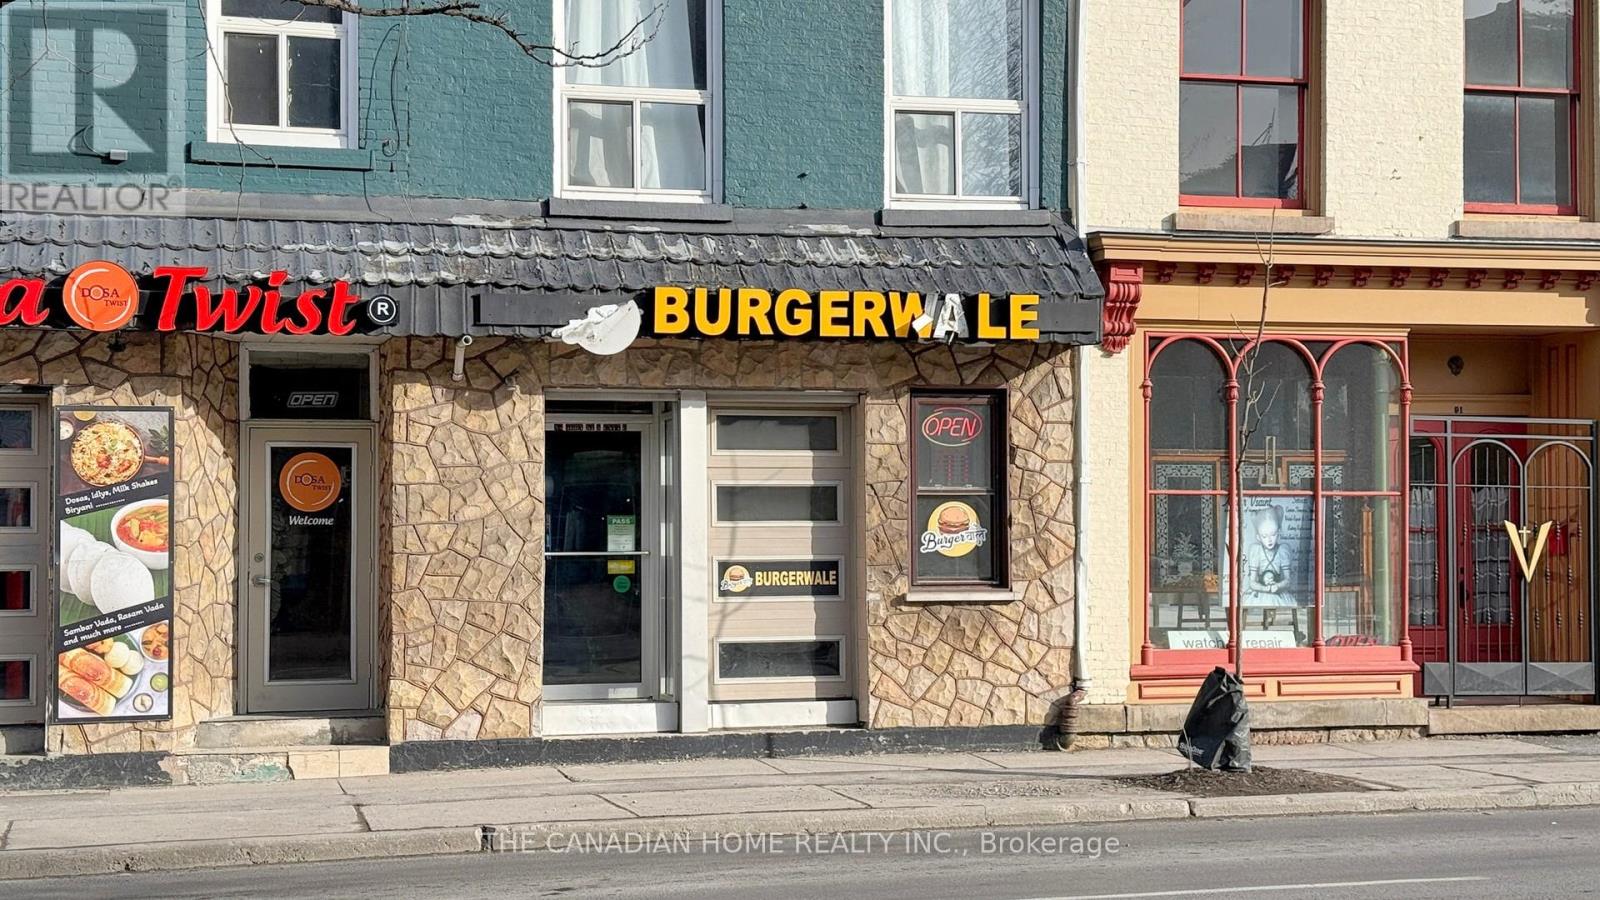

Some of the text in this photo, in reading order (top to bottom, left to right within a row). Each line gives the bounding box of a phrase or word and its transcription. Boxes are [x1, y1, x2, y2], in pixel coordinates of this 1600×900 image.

[81, 287, 118, 301] DOSA
[154, 266, 360, 335] Twist
[653, 286, 1041, 341] BURGERWALE
[289, 394, 336, 406] OPEN
[925, 416, 977, 437] OPEN
[294, 473, 325, 486] DOSA
[65, 495, 91, 505] Dosas,
[112, 484, 130, 494] Milk
[131, 479, 158, 490] Shakes
[65, 503, 93, 515] Biryani
[289, 515, 334, 526] Welcome
[755, 570, 837, 586] BURGERWALE
[64, 602, 165, 636] Sambar Vada, Rasam Vada
[64, 625, 122, 646] and much more
[1182, 637, 1282, 649] watch repair
